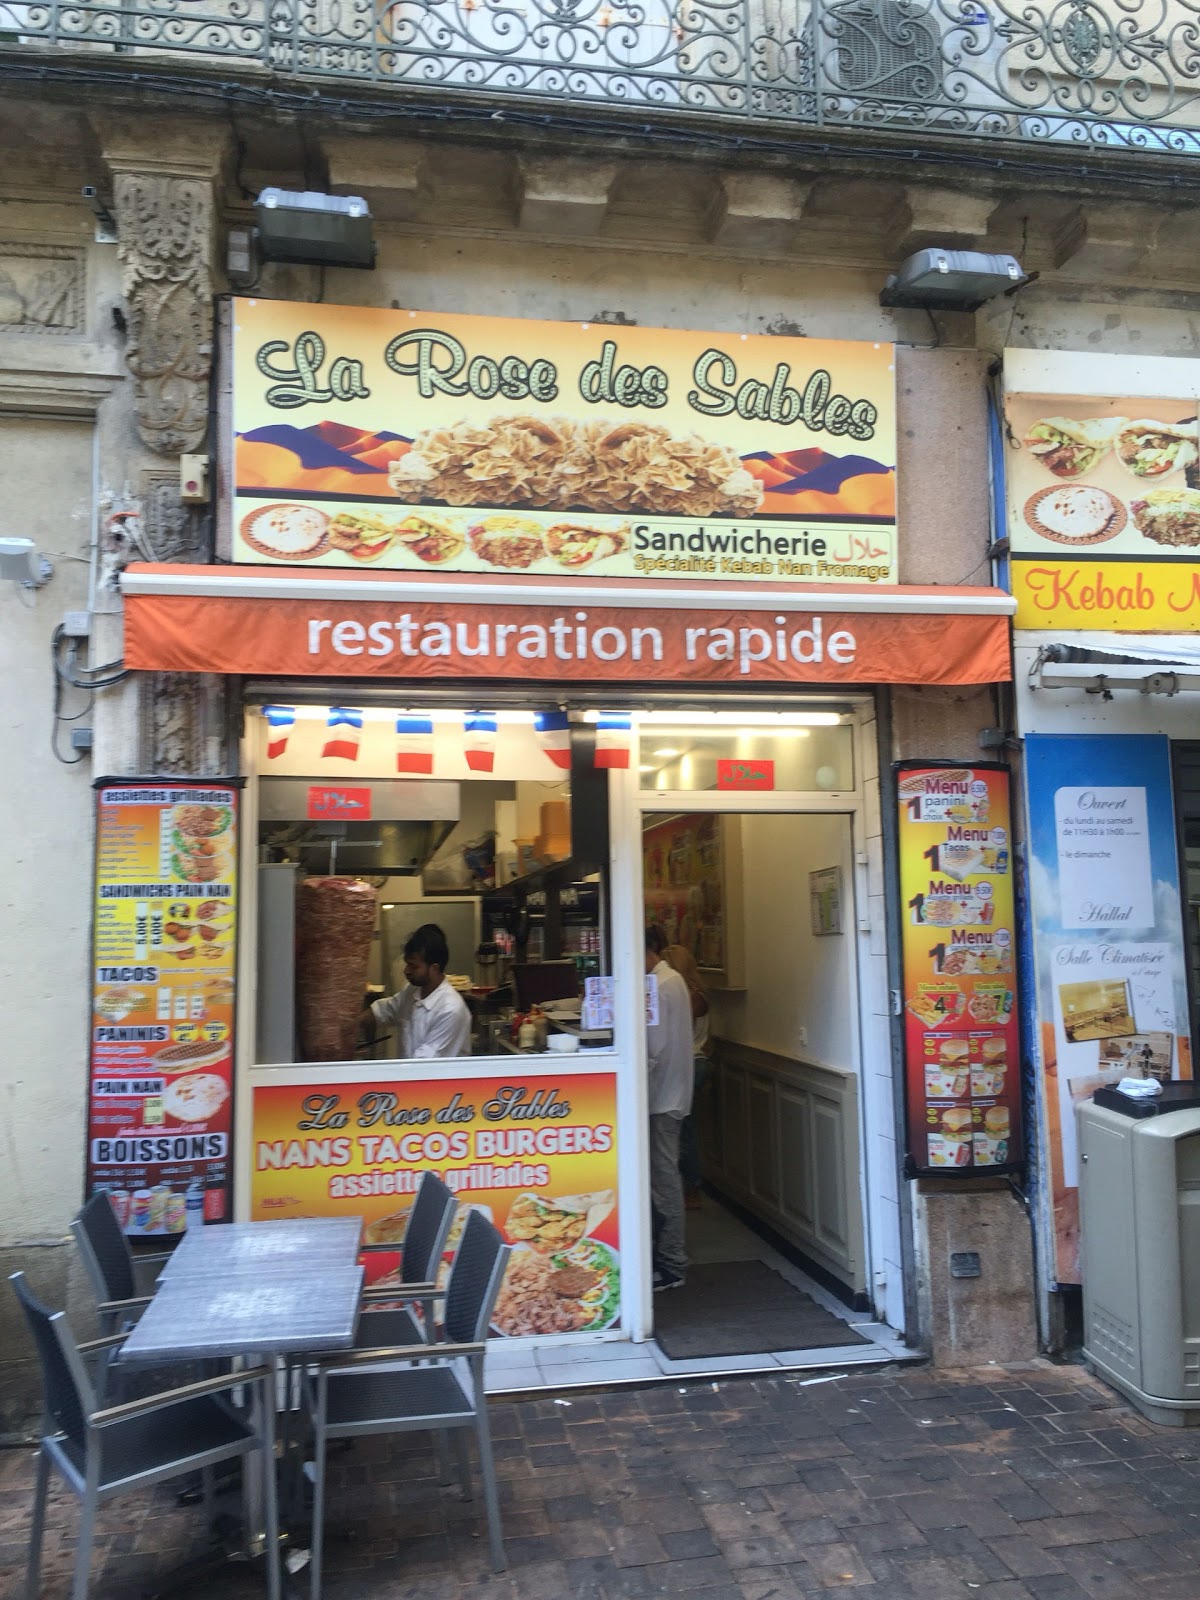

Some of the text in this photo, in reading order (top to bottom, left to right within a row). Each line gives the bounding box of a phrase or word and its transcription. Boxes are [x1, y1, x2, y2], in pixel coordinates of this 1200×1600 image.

[256, 329, 877, 441] La Rose des Sables
[634, 525, 826, 556] Sandwicherie
[634, 554, 890, 582] Spécialité Kebab Nan Fromage
[1025, 568, 1154, 611] Kebab
[307, 612, 857, 675] restauration rapide
[105, 790, 232, 804] assiettes grillades
[925, 779, 968, 794] Menu
[907, 796, 921, 819] 1
[925, 795, 966, 808] panini
[1078, 791, 1127, 810] Ouvert
[947, 826, 988, 841] Menu
[924, 845, 941, 872] 1
[942, 843, 969, 851] Tacos
[1074, 850, 1111, 858] dimanche
[930, 880, 971, 894] Menu
[909, 893, 924, 923] 1
[951, 929, 992, 944] Menu
[929, 943, 945, 973] 1
[1056, 945, 1092, 966] Salle
[100, 967, 157, 982] TACOS
[298, 1087, 571, 1130] La Rose des Sables
[98, 1135, 221, 1162] BOISSONS
[257, 1124, 613, 1170] NANS TACOS BURGERS
[330, 1162, 549, 1197] assiette grillades
